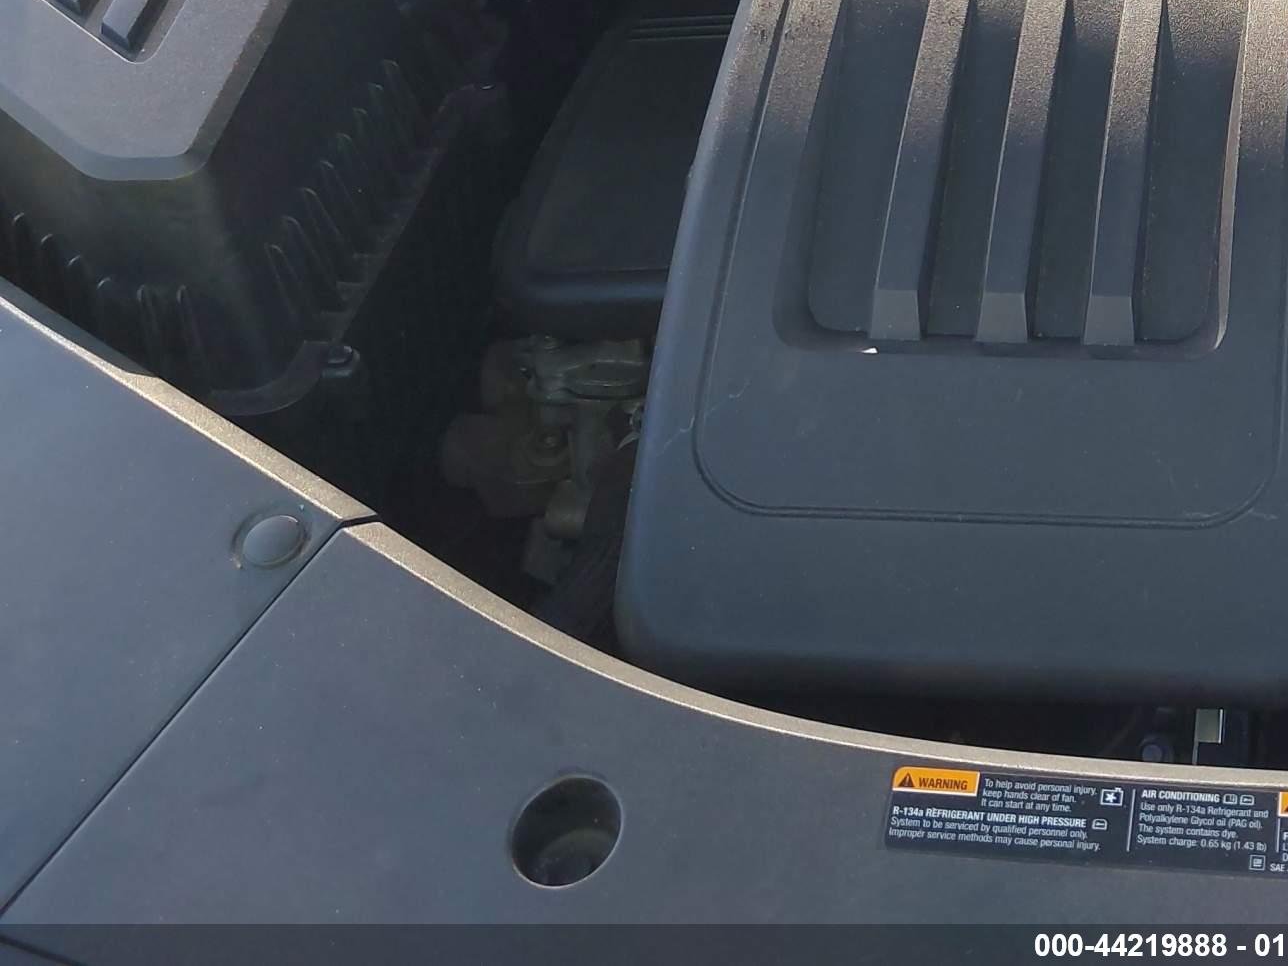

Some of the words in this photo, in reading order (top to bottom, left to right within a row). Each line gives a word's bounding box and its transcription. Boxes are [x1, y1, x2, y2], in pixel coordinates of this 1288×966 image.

[919, 777, 968, 791] WARNING
[985, 778, 994, 787] To
[996, 779, 1013, 790] help
[1015, 782, 1037, 790] avoid
[1038, 784, 1072, 793] personal
[982, 789, 1003, 798] keep
[1004, 791, 1028, 799] hands
[1030, 792, 1049, 801] clear
[1052, 794, 1060, 802] of
[1061, 794, 1077, 802] fan.
[1141, 789, 1157, 799] AIR
[1158, 791, 1220, 803] CONDITIONING
[981, 798, 986, 806] It
[1005, 800, 1024, 808] start
[1035, 804, 1051, 812] any
[1052, 803, 1072, 812] time.
[1140, 802, 1154, 811] Use
[1157, 804, 1174, 814] only
[1176, 804, 1206, 815] R-134a
[1207, 806, 1251, 818] Refrigerant
[1253, 809, 1269, 818] and
[892, 805, 924, 816] R-134a
[926, 807, 985, 821] REFRIGERANT
[986, 813, 1017, 823] UNDER
[1018, 815, 1040, 824] HIGH
[1041, 816, 1087, 828] PRESSURE
[1139, 813, 1189, 824] Polyalkylene
[1191, 816, 1215, 827] Glycol
[1216, 817, 1226, 826] oil
[1228, 818, 1247, 829] (PAG
[890, 816, 921, 827] System
[922, 819, 931, 827] to
[933, 820, 942, 828] be
[944, 822, 979, 831] serviced
[980, 824, 990, 833] by
[992, 825, 1027, 835] qualified
[1028, 827, 1068, 836] personnel
[1070, 829, 1088, 839] only.
[1138, 823, 1153, 832] The
[1155, 825, 1184, 836] system
[1185, 827, 1220, 837] contains
[1222, 829, 1239, 839] dye.
[889, 827, 925, 839] Improper
[927, 831, 956, 840] service
[958, 833, 993, 843] methods
[994, 837, 1012, 846] may
[1014, 837, 1038, 845] cause
[1040, 839, 1075, 848] personal
[1076, 841, 1101, 852] injury.
[1137, 834, 1167, 845] System
[1200, 839, 1219, 848] 0.65
[1220, 841, 1231, 851] kg
[1233, 841, 1254, 851] (1.43
[1256, 842, 1267, 852] lb)
[1270, 863, 1285, 872] SAE
